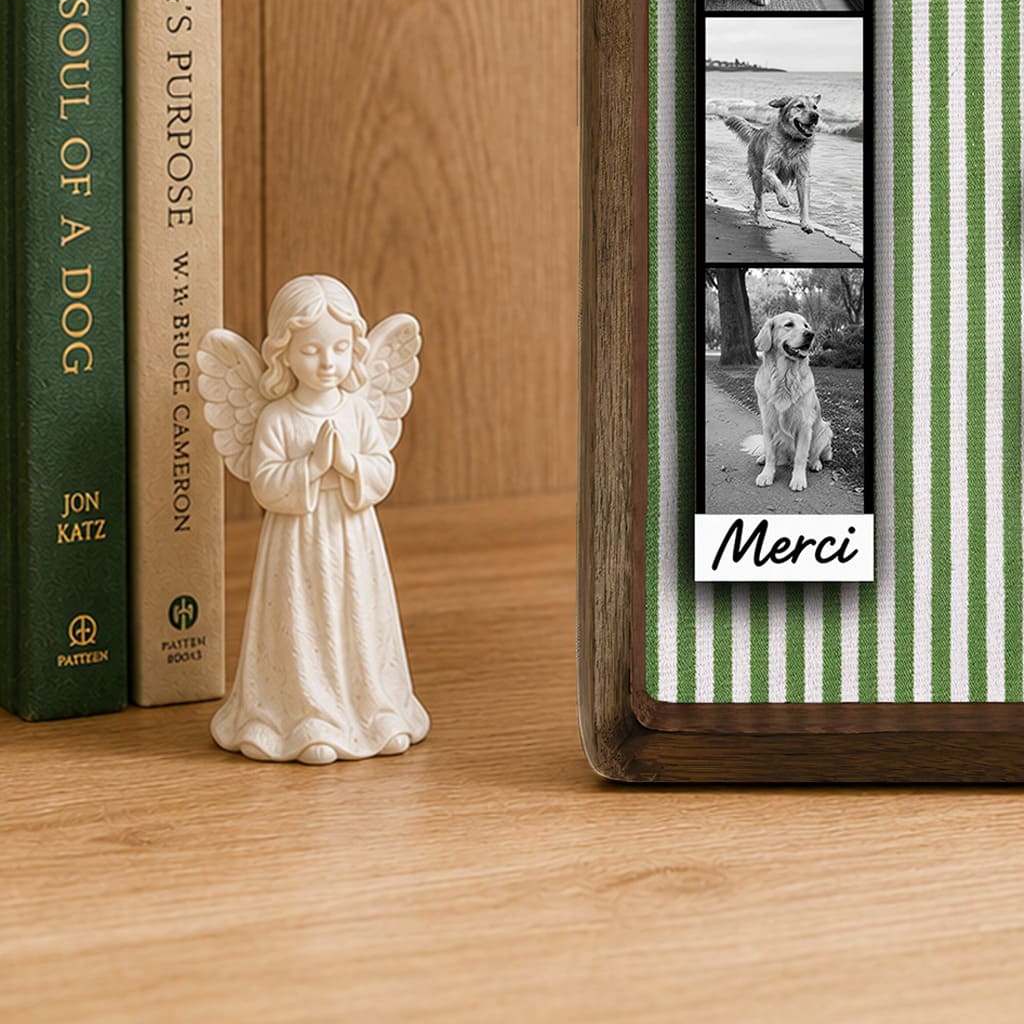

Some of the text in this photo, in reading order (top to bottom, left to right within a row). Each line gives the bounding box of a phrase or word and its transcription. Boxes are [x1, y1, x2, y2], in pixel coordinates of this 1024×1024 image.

[167, 51, 193, 227] PURPOSE
[61, 138, 91, 196] OF
[61, 216, 90, 246] A
[62, 264, 92, 374] DOG
[173, 405, 190, 532] CAMERON
[58, 520, 105, 543] KATZ
[62, 491, 99, 517] JON
[712, 519, 858, 571] Merci
